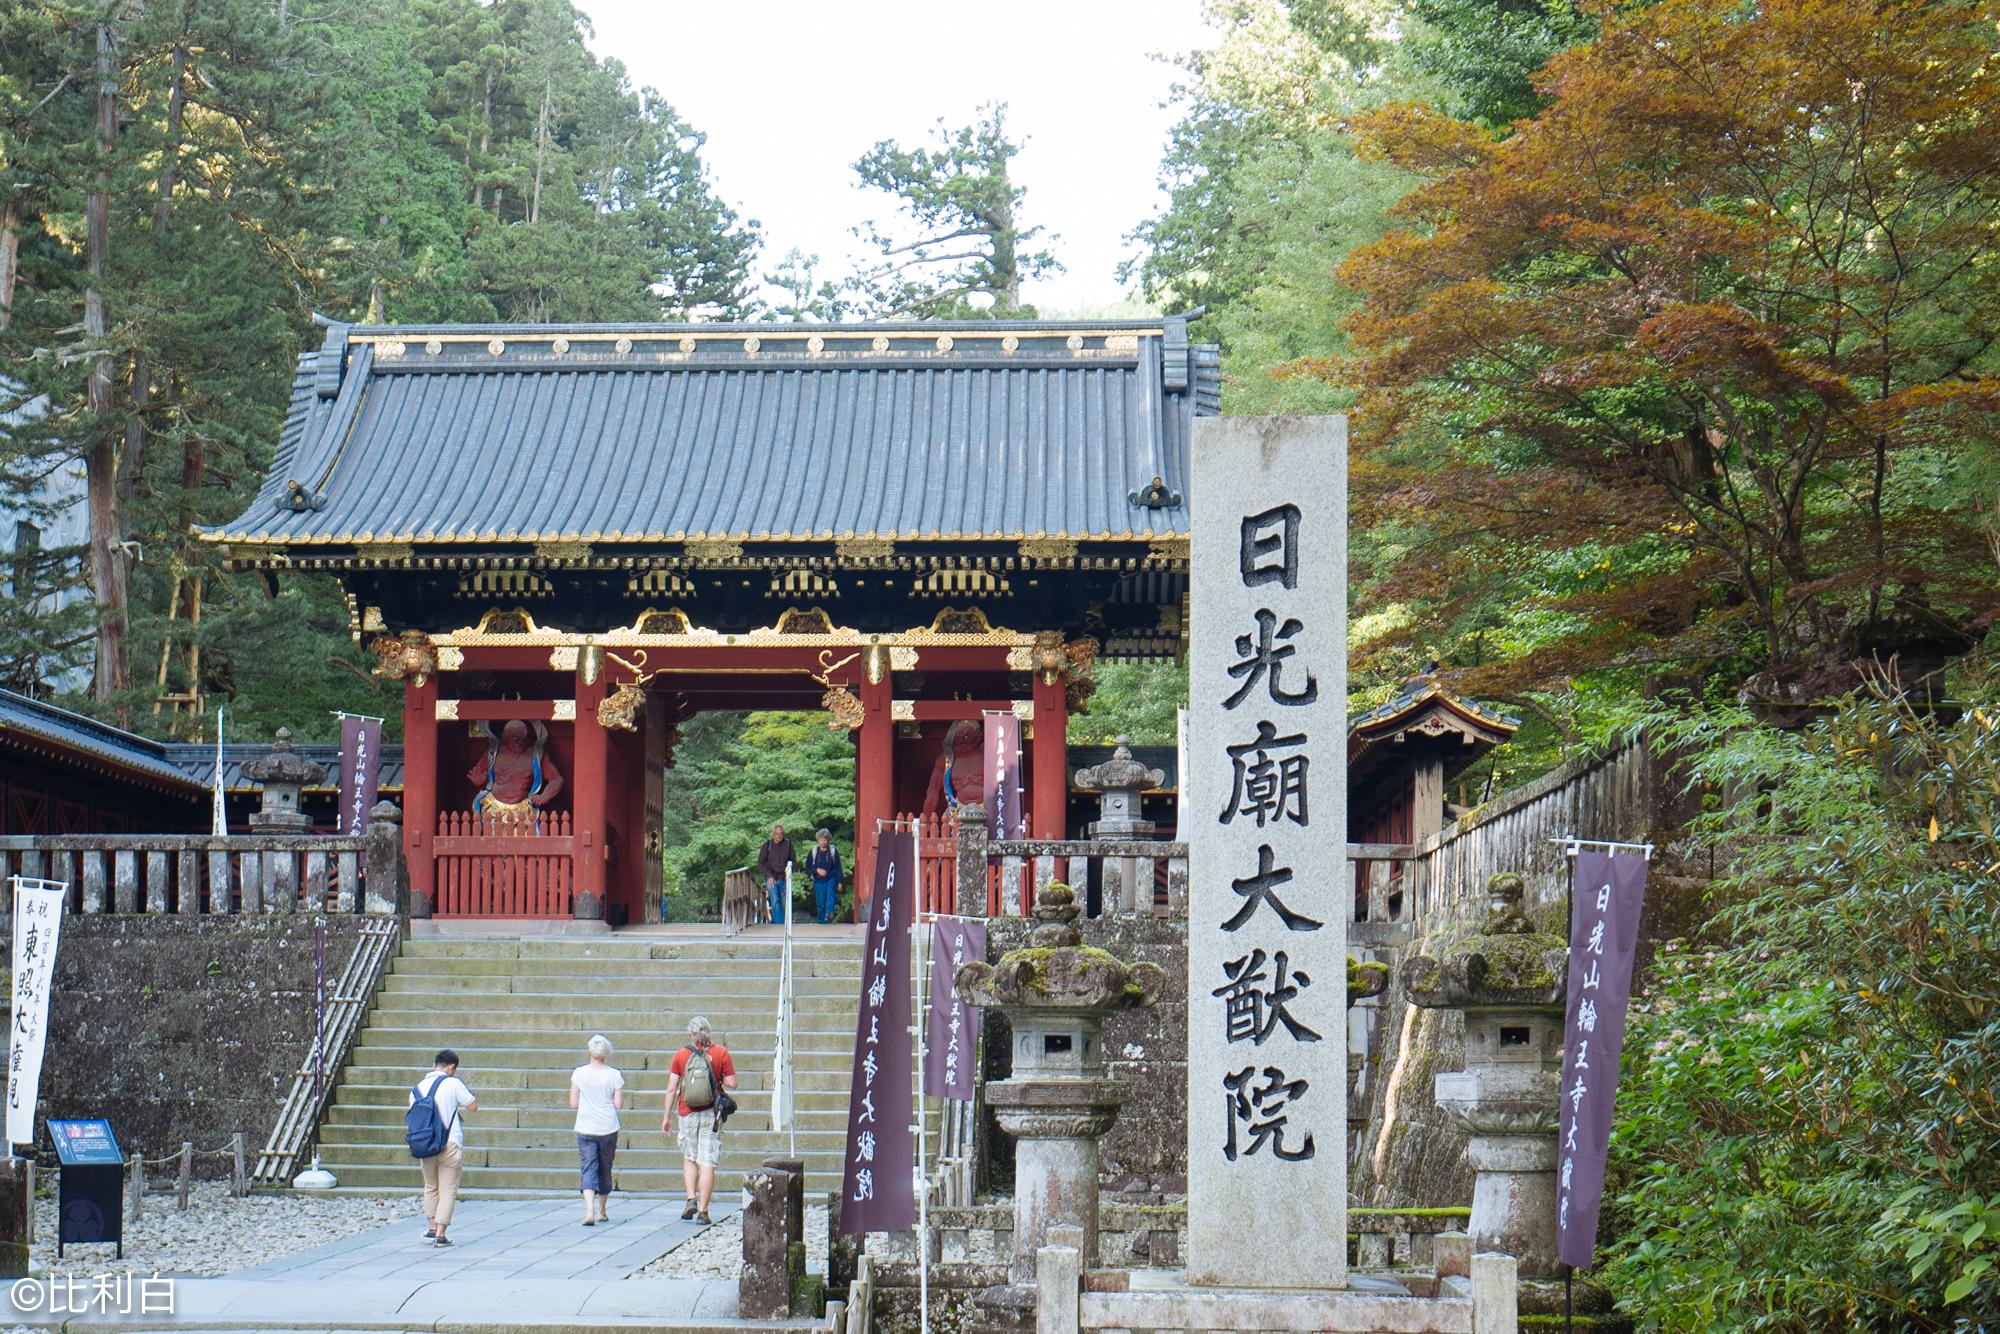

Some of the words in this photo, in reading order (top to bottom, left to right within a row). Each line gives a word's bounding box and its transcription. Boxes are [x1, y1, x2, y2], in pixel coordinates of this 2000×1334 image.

[944, 933, 964, 1085] 日光王寺大猷院
[1212, 503, 1323, 1162] 日光廟大猷院
